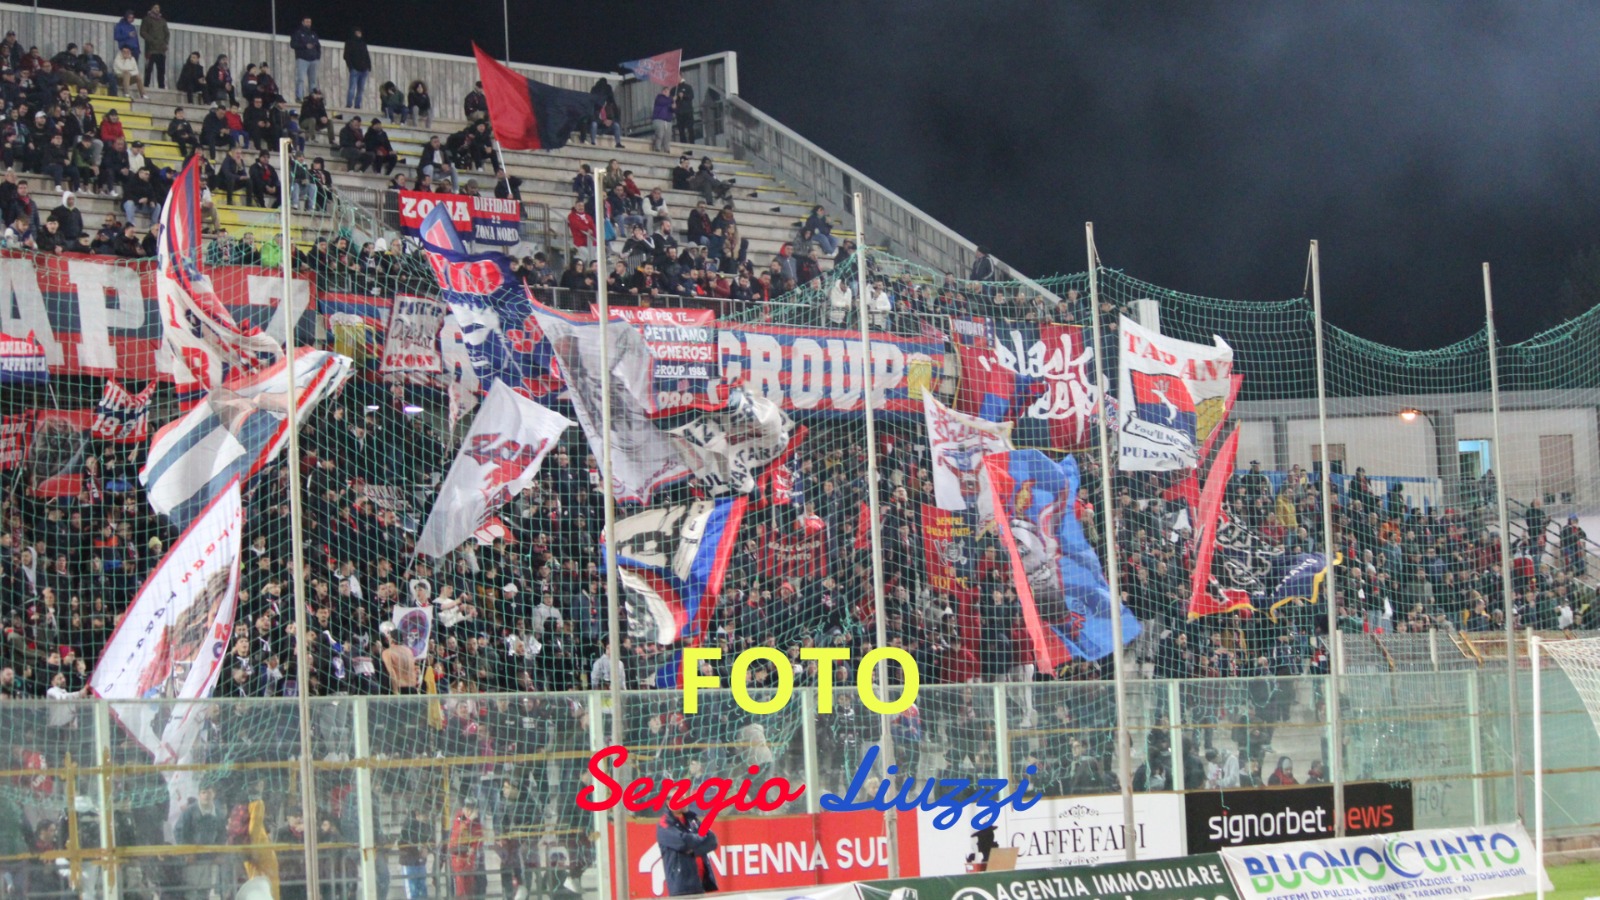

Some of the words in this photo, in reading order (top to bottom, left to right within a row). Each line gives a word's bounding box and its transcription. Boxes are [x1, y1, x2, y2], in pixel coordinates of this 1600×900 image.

[475, 225, 495, 240] ZONA
[496, 226, 519, 242] NORD
[995, 879, 1089, 900] AGENZIA
[1094, 864, 1225, 895] IMMOBILIARE
[1324, 887, 1361, 899] PULIZIA
[1369, 875, 1455, 893] DISINFESTAZIONE
